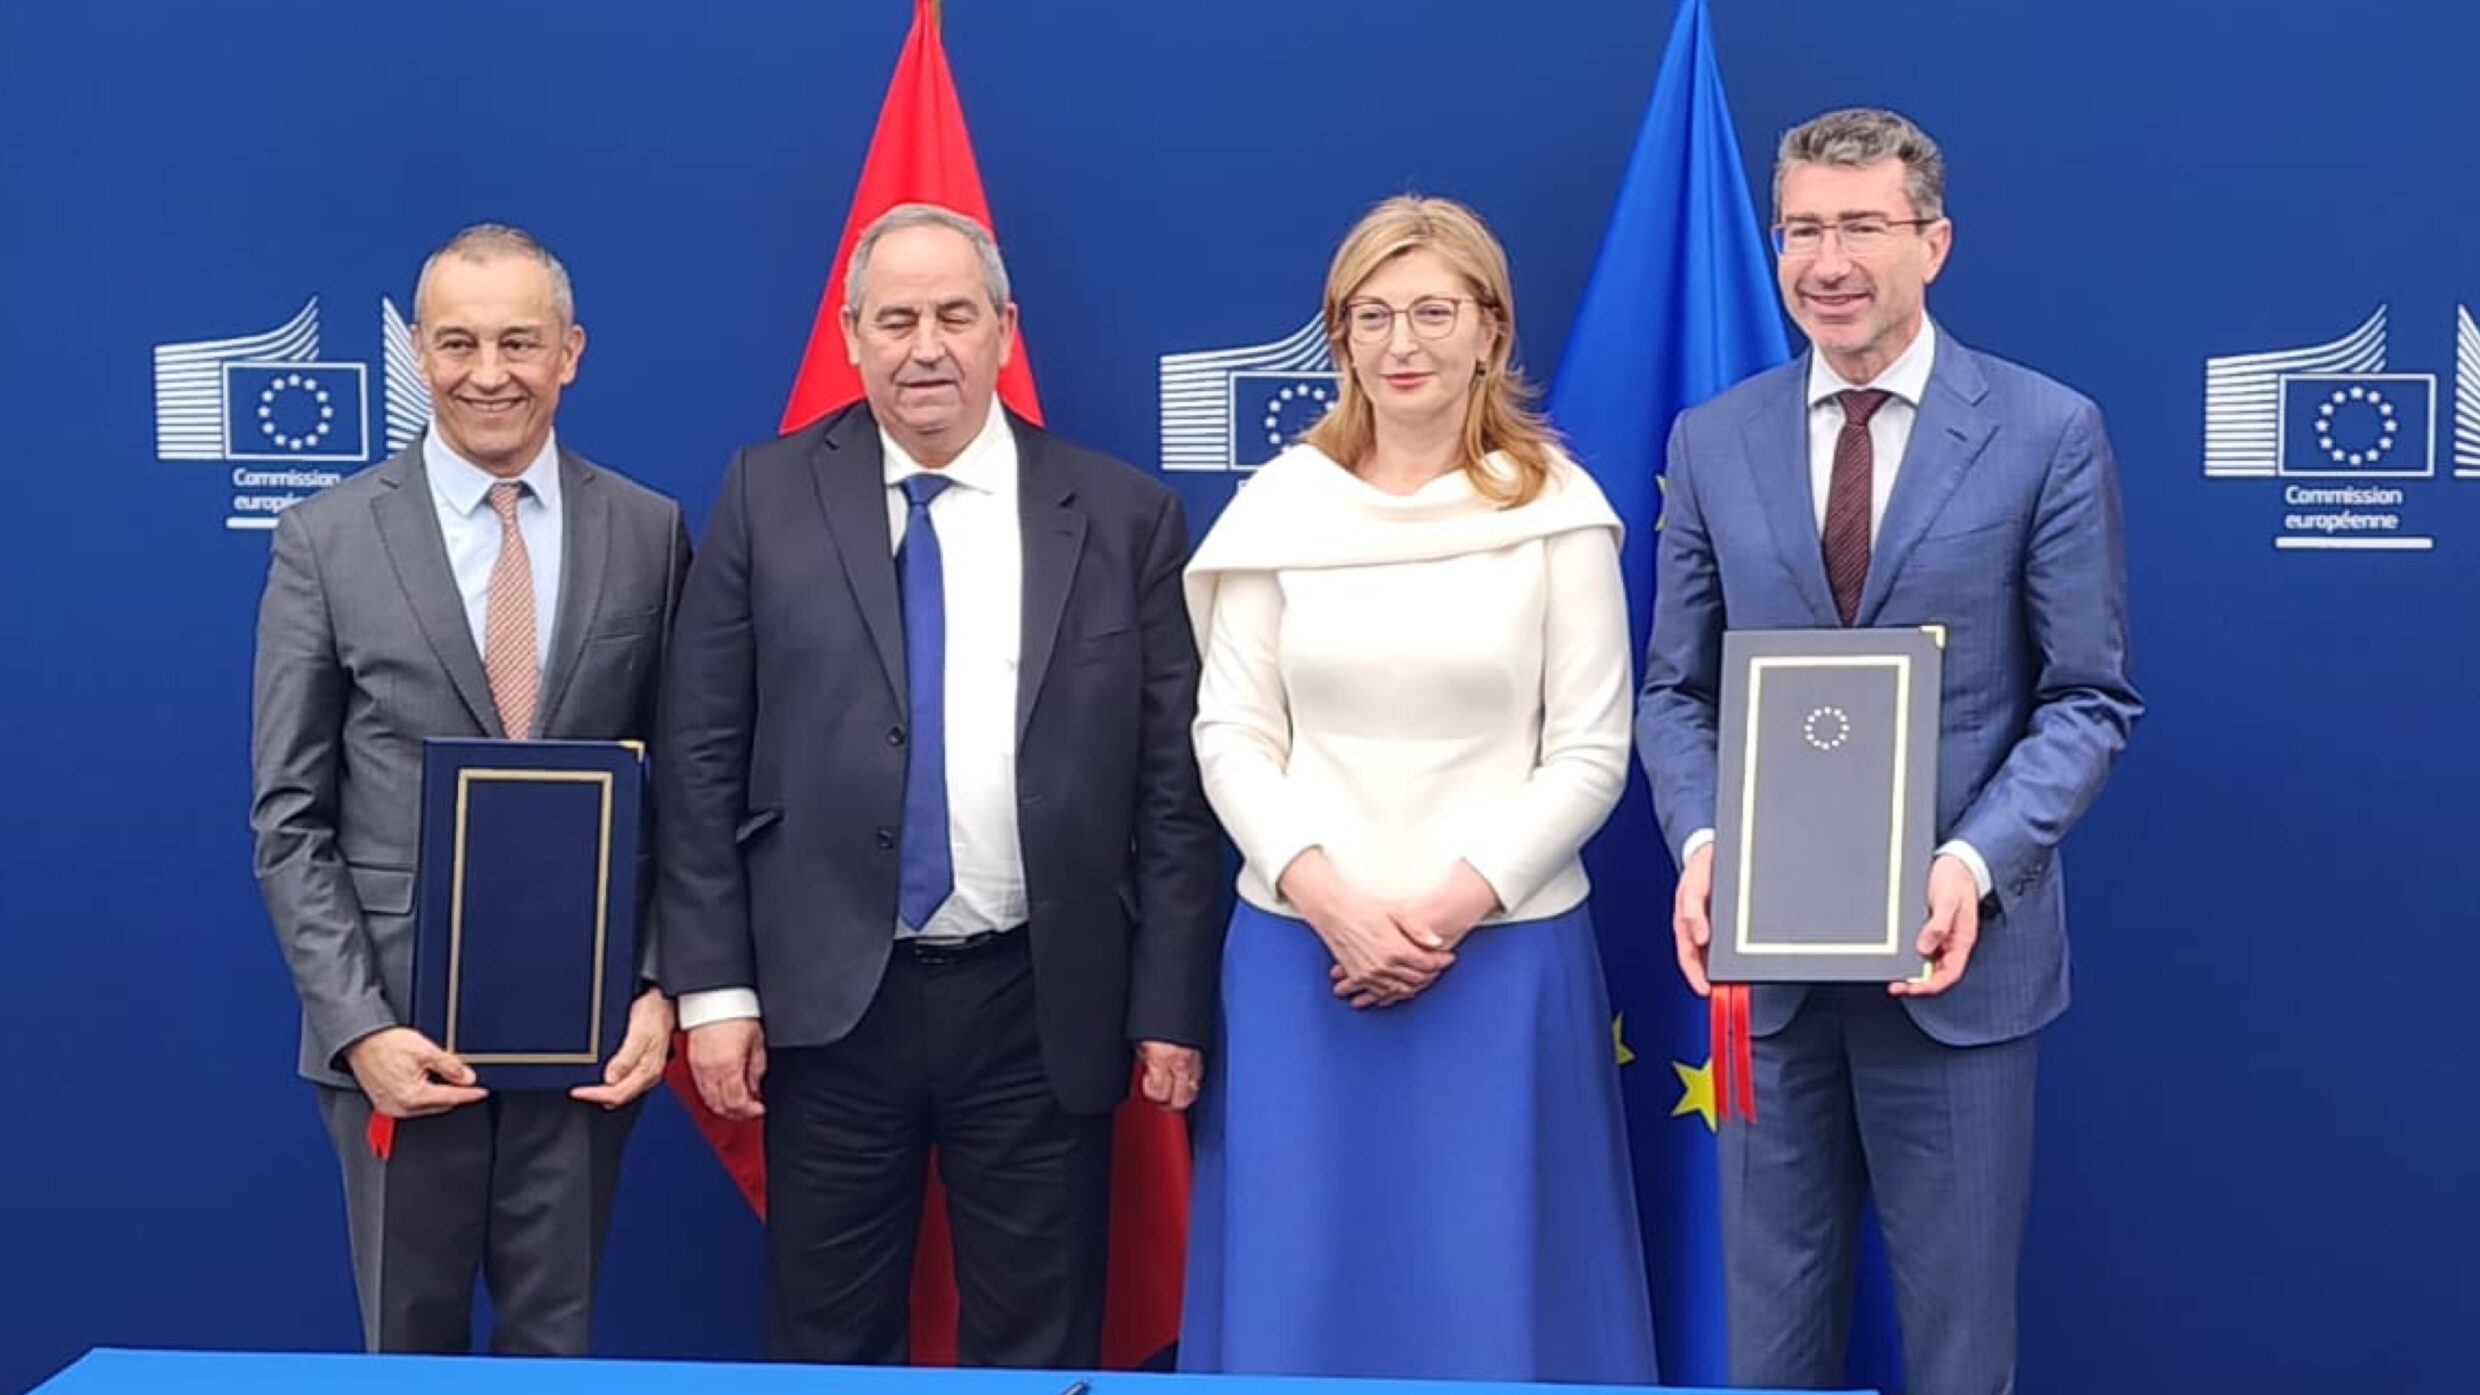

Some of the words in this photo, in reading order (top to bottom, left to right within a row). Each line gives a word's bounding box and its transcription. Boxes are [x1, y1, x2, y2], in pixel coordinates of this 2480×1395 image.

[233, 468, 341, 487] Commission
[2285, 485, 2402, 505] Commission
[2284, 510, 2398, 533] européenne
